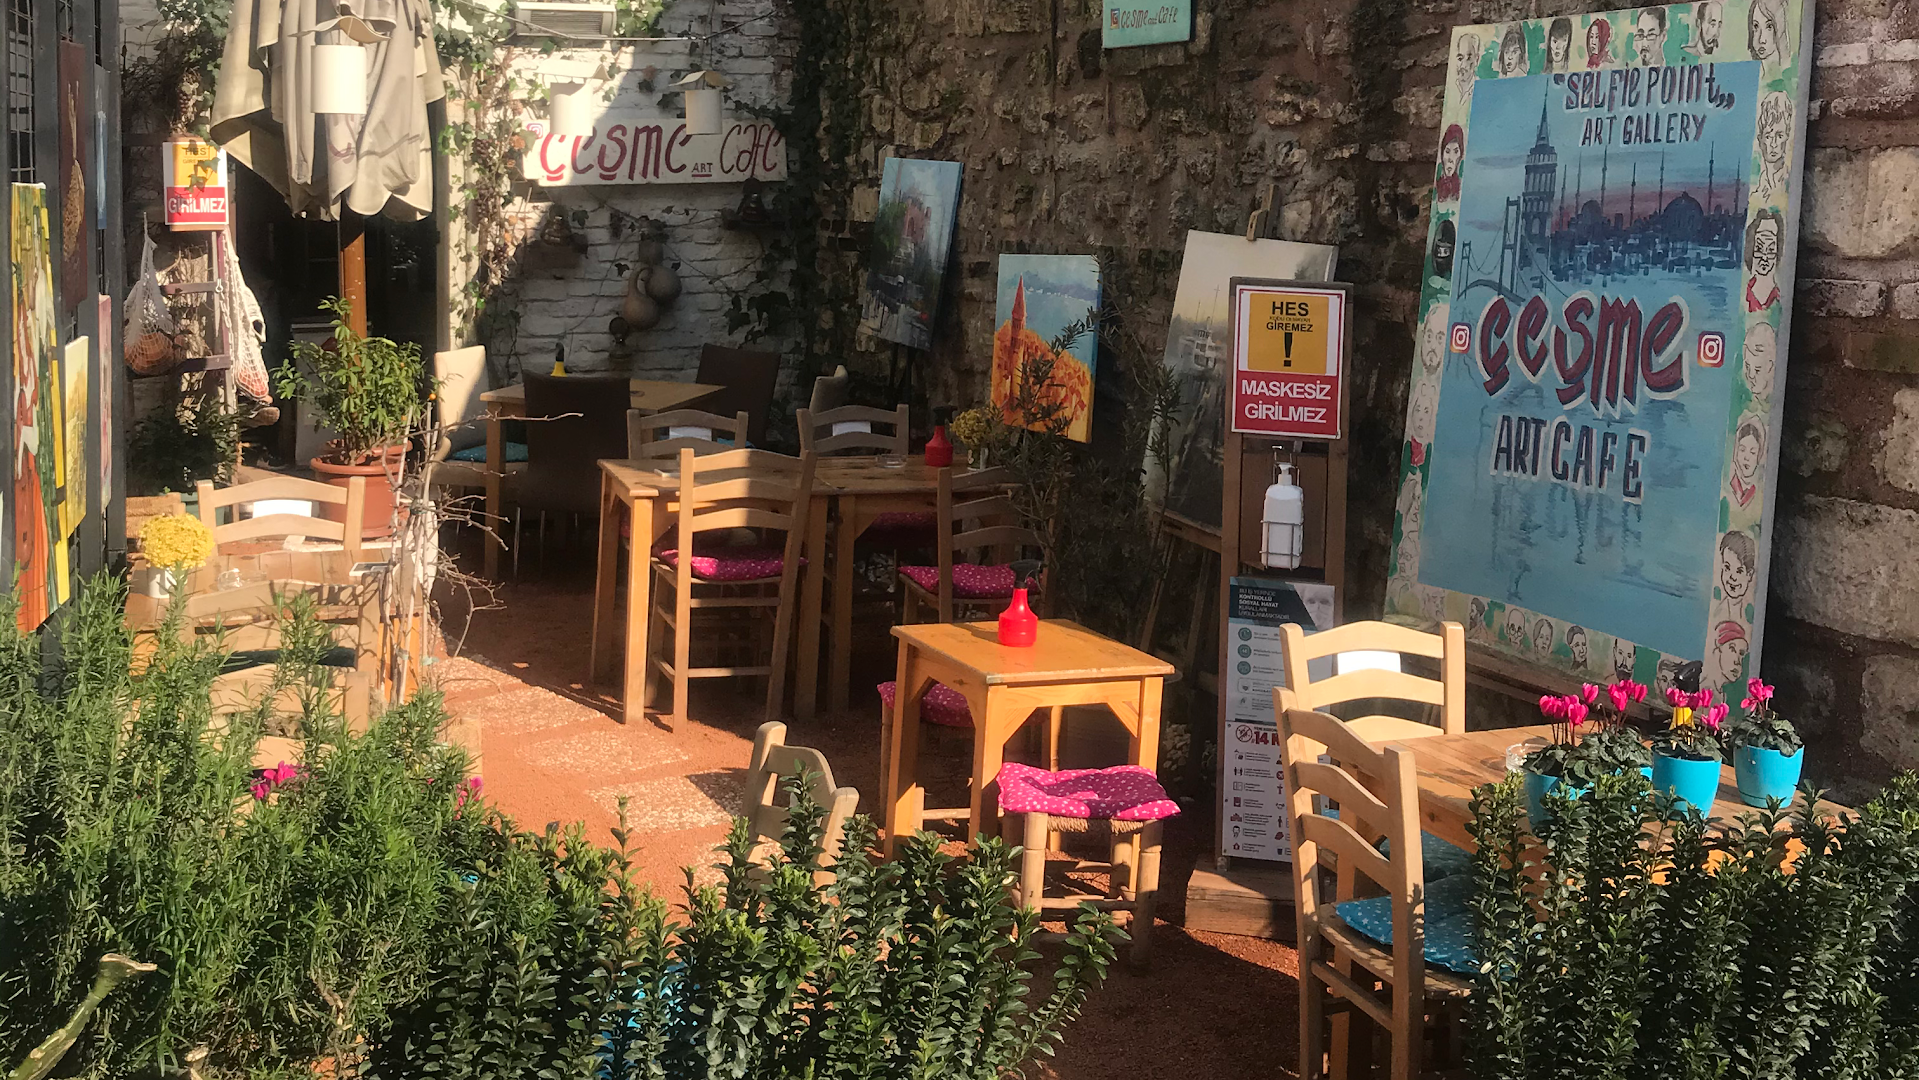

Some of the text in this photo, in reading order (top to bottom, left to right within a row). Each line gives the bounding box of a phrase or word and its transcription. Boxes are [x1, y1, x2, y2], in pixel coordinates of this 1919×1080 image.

[1581, 112, 1708, 147] ART GALLERY
[691, 162, 713, 177] ART
[168, 194, 225, 214] GİRİLMEZ
[1271, 301, 1309, 317] HES
[1266, 320, 1314, 333] GİREMEZ
[1241, 379, 1332, 400] MASKESİZ
[1244, 400, 1327, 424] GİRİLMEZ
[1491, 415, 1648, 502] ART CAFE
[1253, 731, 1269, 745] 14
